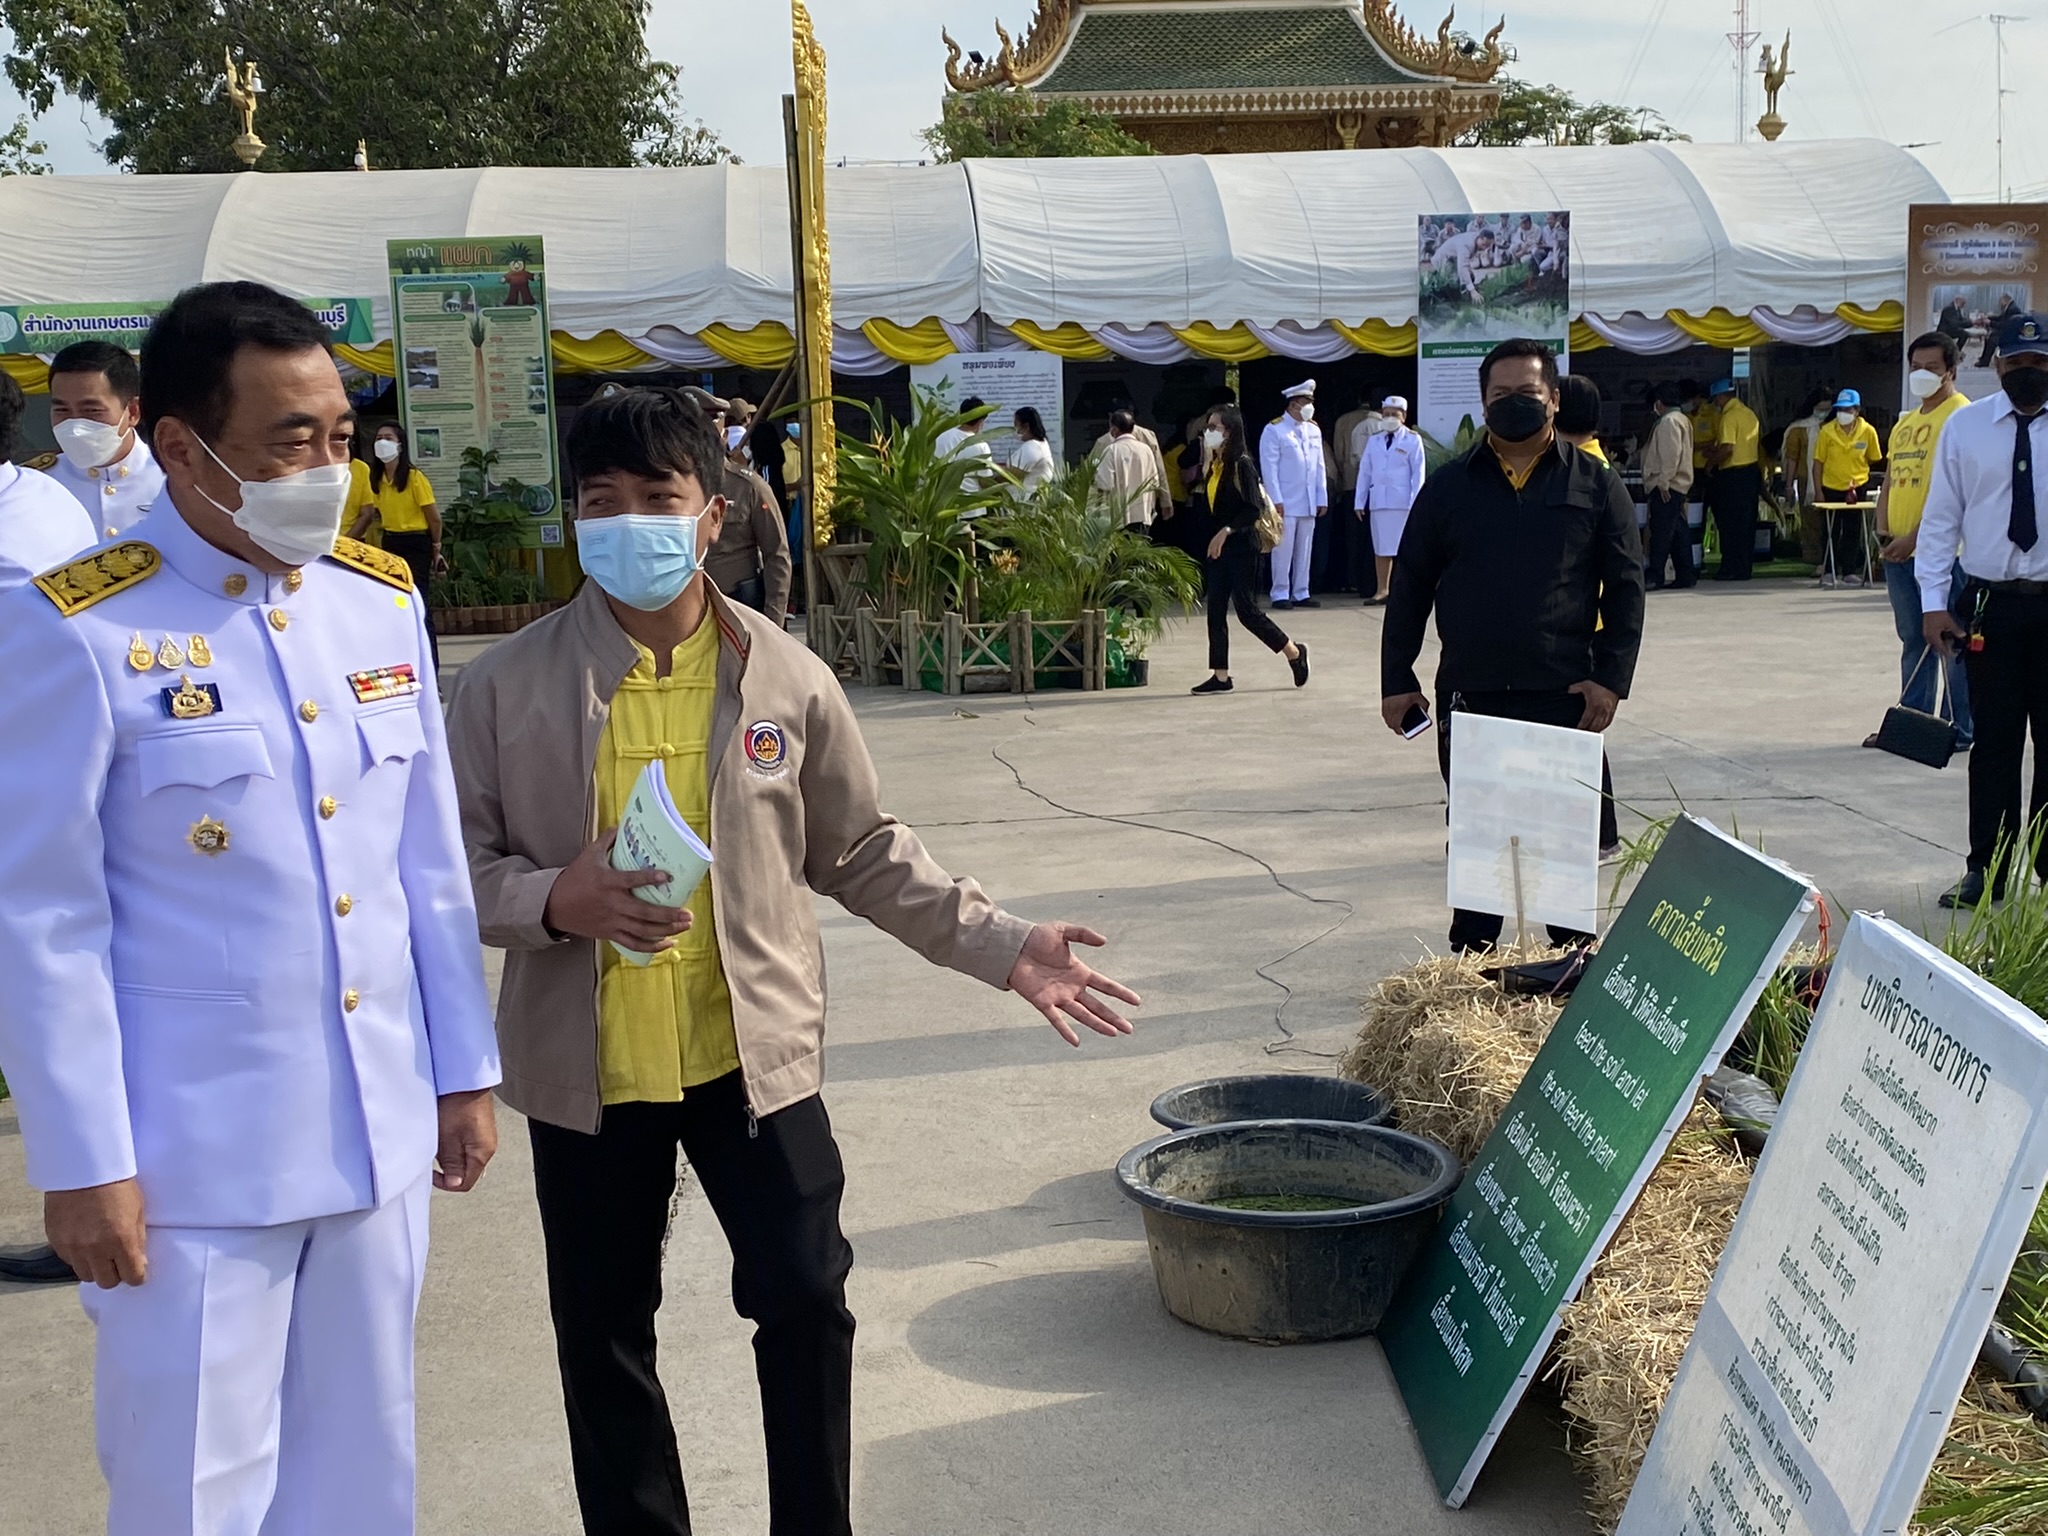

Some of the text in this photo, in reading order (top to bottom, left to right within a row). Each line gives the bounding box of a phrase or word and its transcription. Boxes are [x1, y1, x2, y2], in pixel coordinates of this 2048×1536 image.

[406, 243, 434, 259] หญ้า
[23, 314, 150, 332] สำนักงานเกษตรแ
[1647, 896, 1727, 976] คาถาเลี้ยงดิน
[1603, 954, 1689, 1055] เลี้ยงดิน ให้ดินเลี้ยงพืช
[1861, 974, 1991, 1104] บทพิจารณาอาหาร
[1574, 1020, 1650, 1111] feed the soil and let
[1540, 1070, 1619, 1172] the soil feed the plant
[1449, 1211, 1526, 1347] เลี้ยงแม่ธรณี ให้แม่ธรณี
